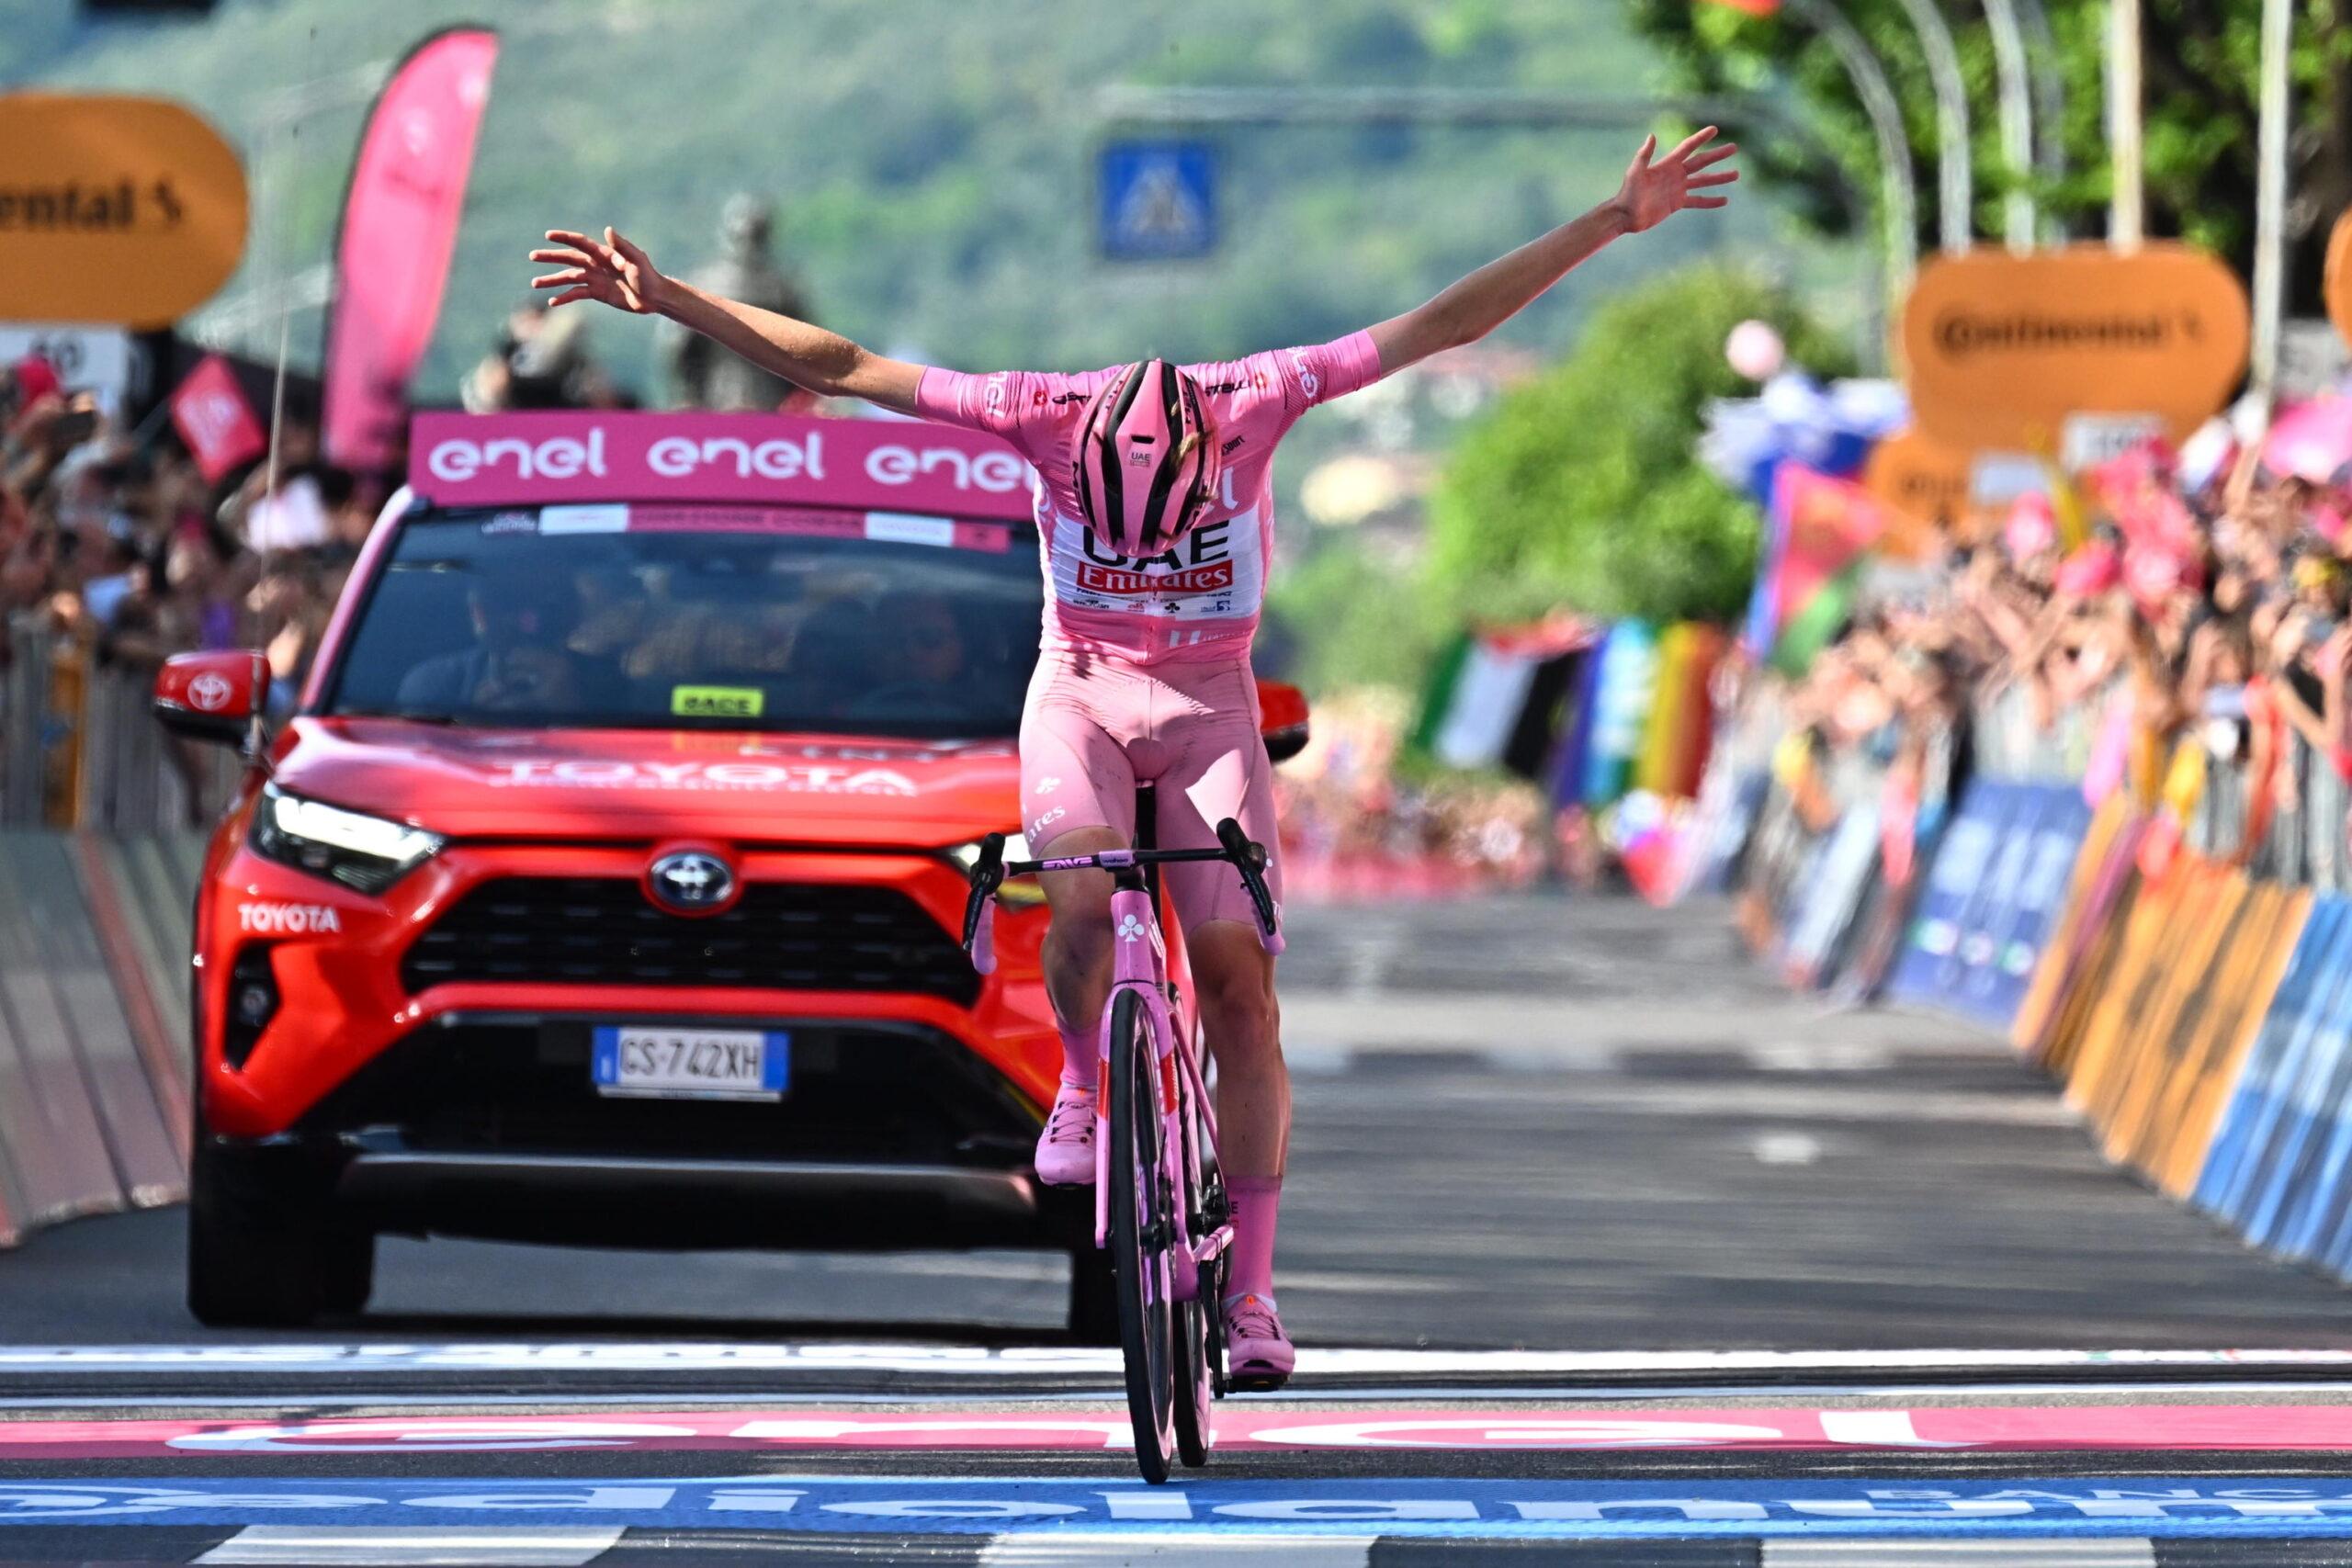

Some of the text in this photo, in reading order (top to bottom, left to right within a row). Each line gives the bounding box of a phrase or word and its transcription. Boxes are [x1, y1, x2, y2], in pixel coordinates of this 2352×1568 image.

[0, 177, 136, 230] ental
[428, 427, 607, 483] enel
[648, 431, 825, 481] enel
[1131, 451, 1151, 462] UAE
[1083, 565, 1229, 590] Emirates
[684, 695, 751, 716] RACE
[493, 760, 917, 797] TOYOTA
[237, 903, 341, 932] TOYOTA
[164, 1410, 1992, 1452] enel
[1861, 1488, 2352, 1500] BANC
